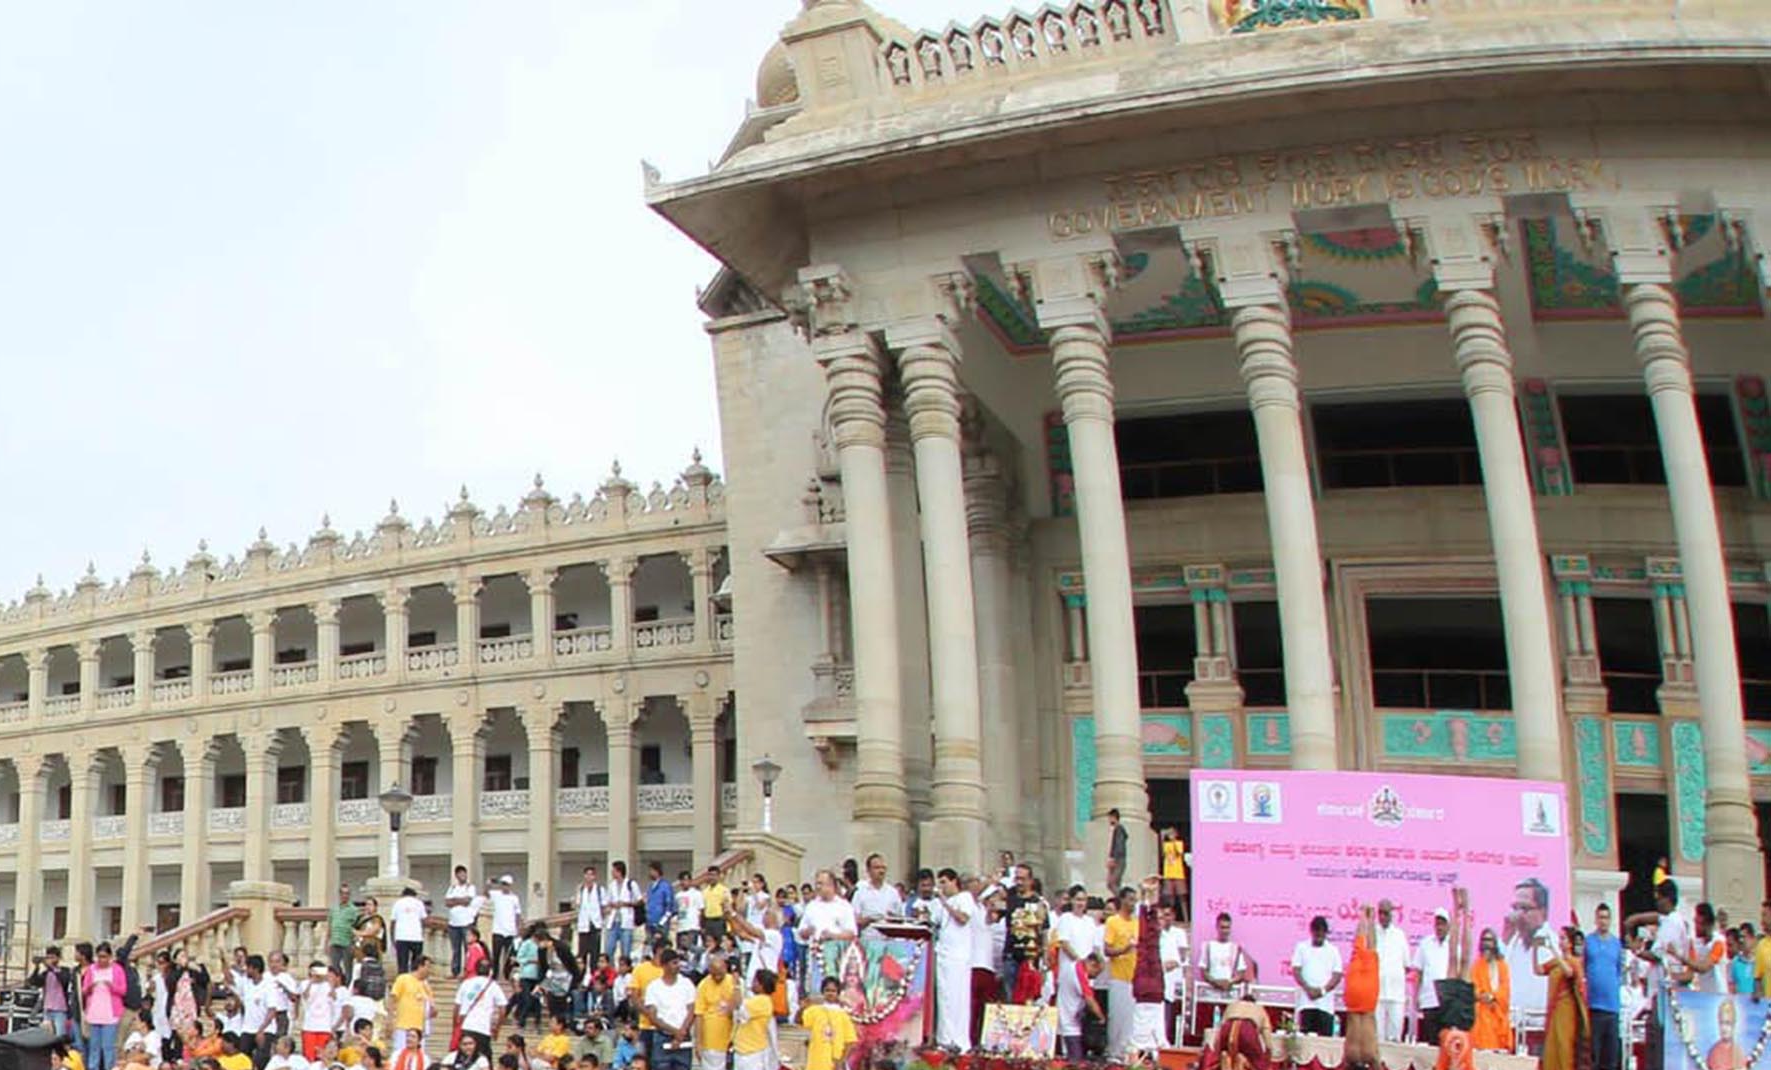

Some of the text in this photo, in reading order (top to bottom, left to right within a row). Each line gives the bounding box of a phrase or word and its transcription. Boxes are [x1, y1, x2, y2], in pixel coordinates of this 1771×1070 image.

[1048, 183, 1271, 238] GOVERNMENT
[1290, 173, 1366, 208] WORK
[1384, 168, 1413, 199] IS
